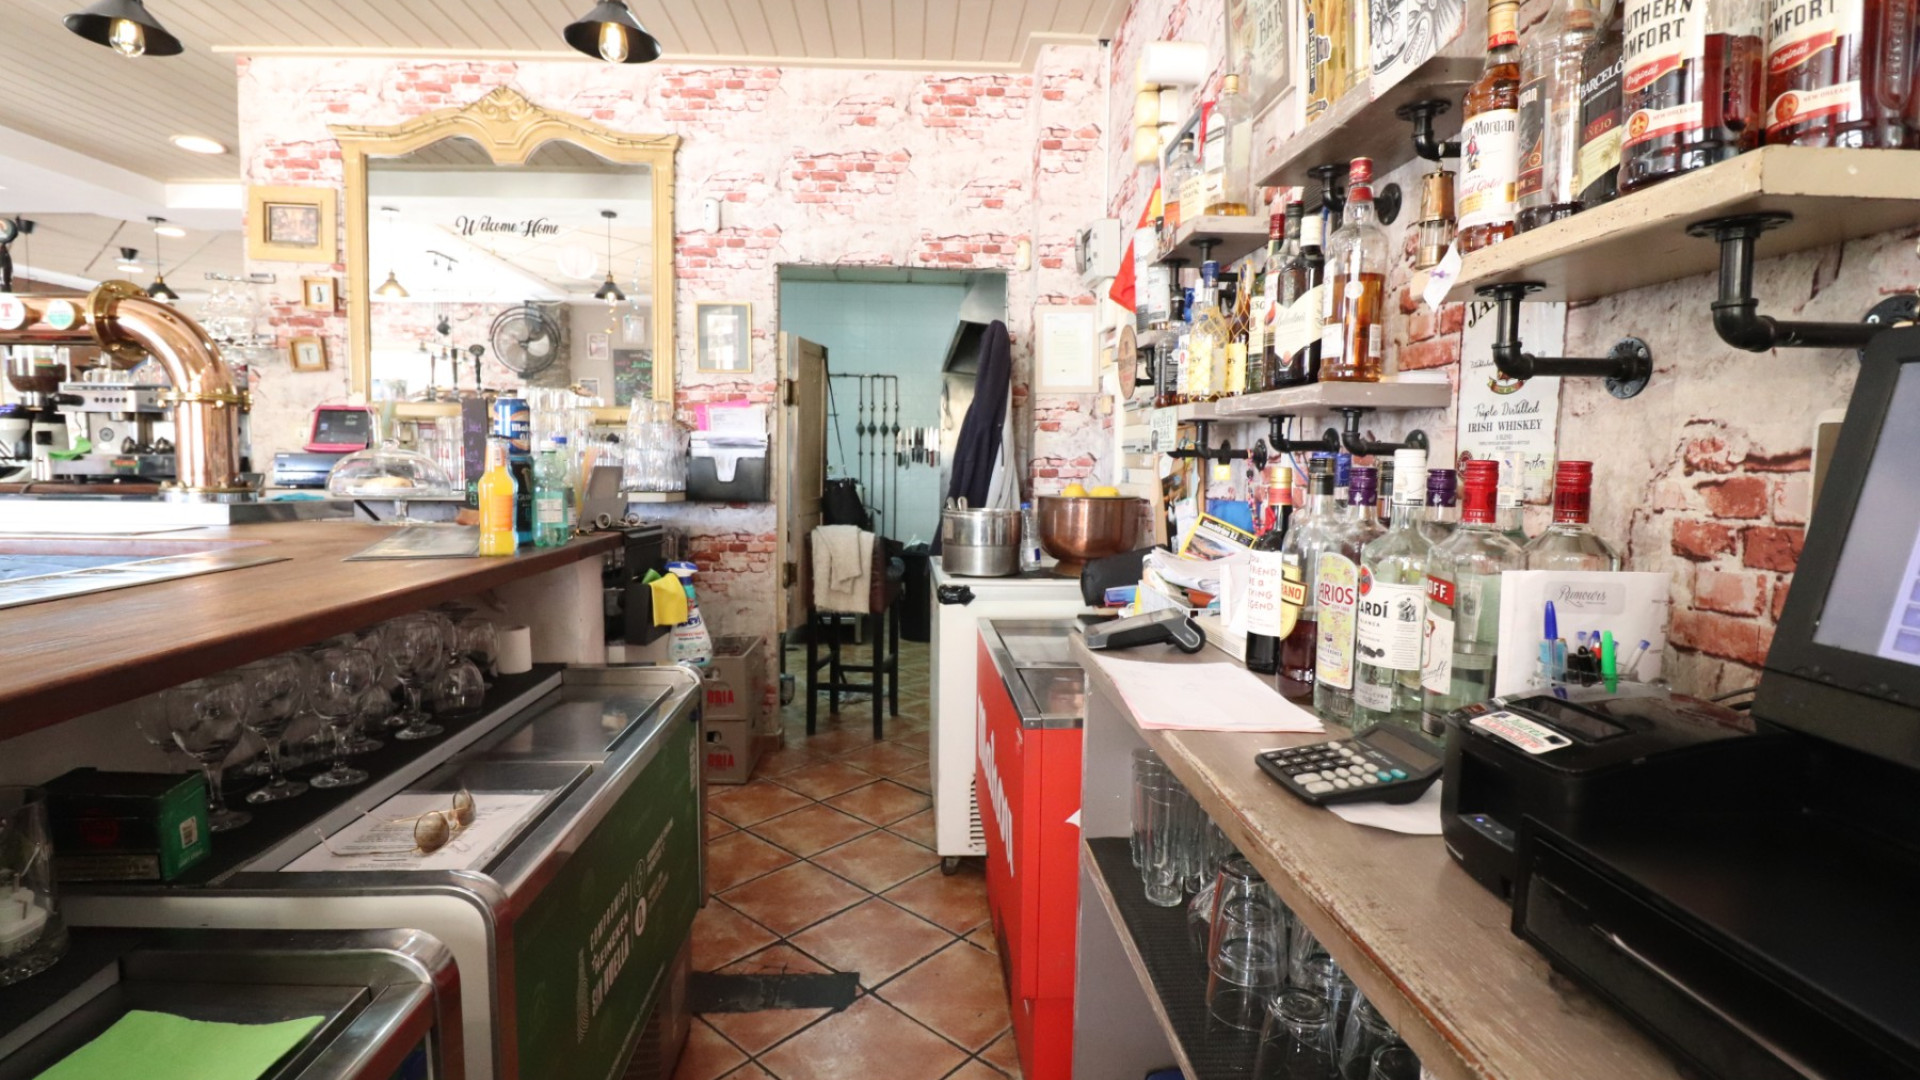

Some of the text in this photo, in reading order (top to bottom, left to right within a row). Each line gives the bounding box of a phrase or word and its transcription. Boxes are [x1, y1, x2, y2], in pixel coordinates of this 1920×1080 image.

[455, 215, 560, 238] Welcome Home
[1474, 400, 1540, 422] Triple Distilled
[1467, 418, 1543, 433] IRISH WHISKEY
[592, 909, 630, 975] HEINEKEN
[604, 933, 630, 995] HUELLA
